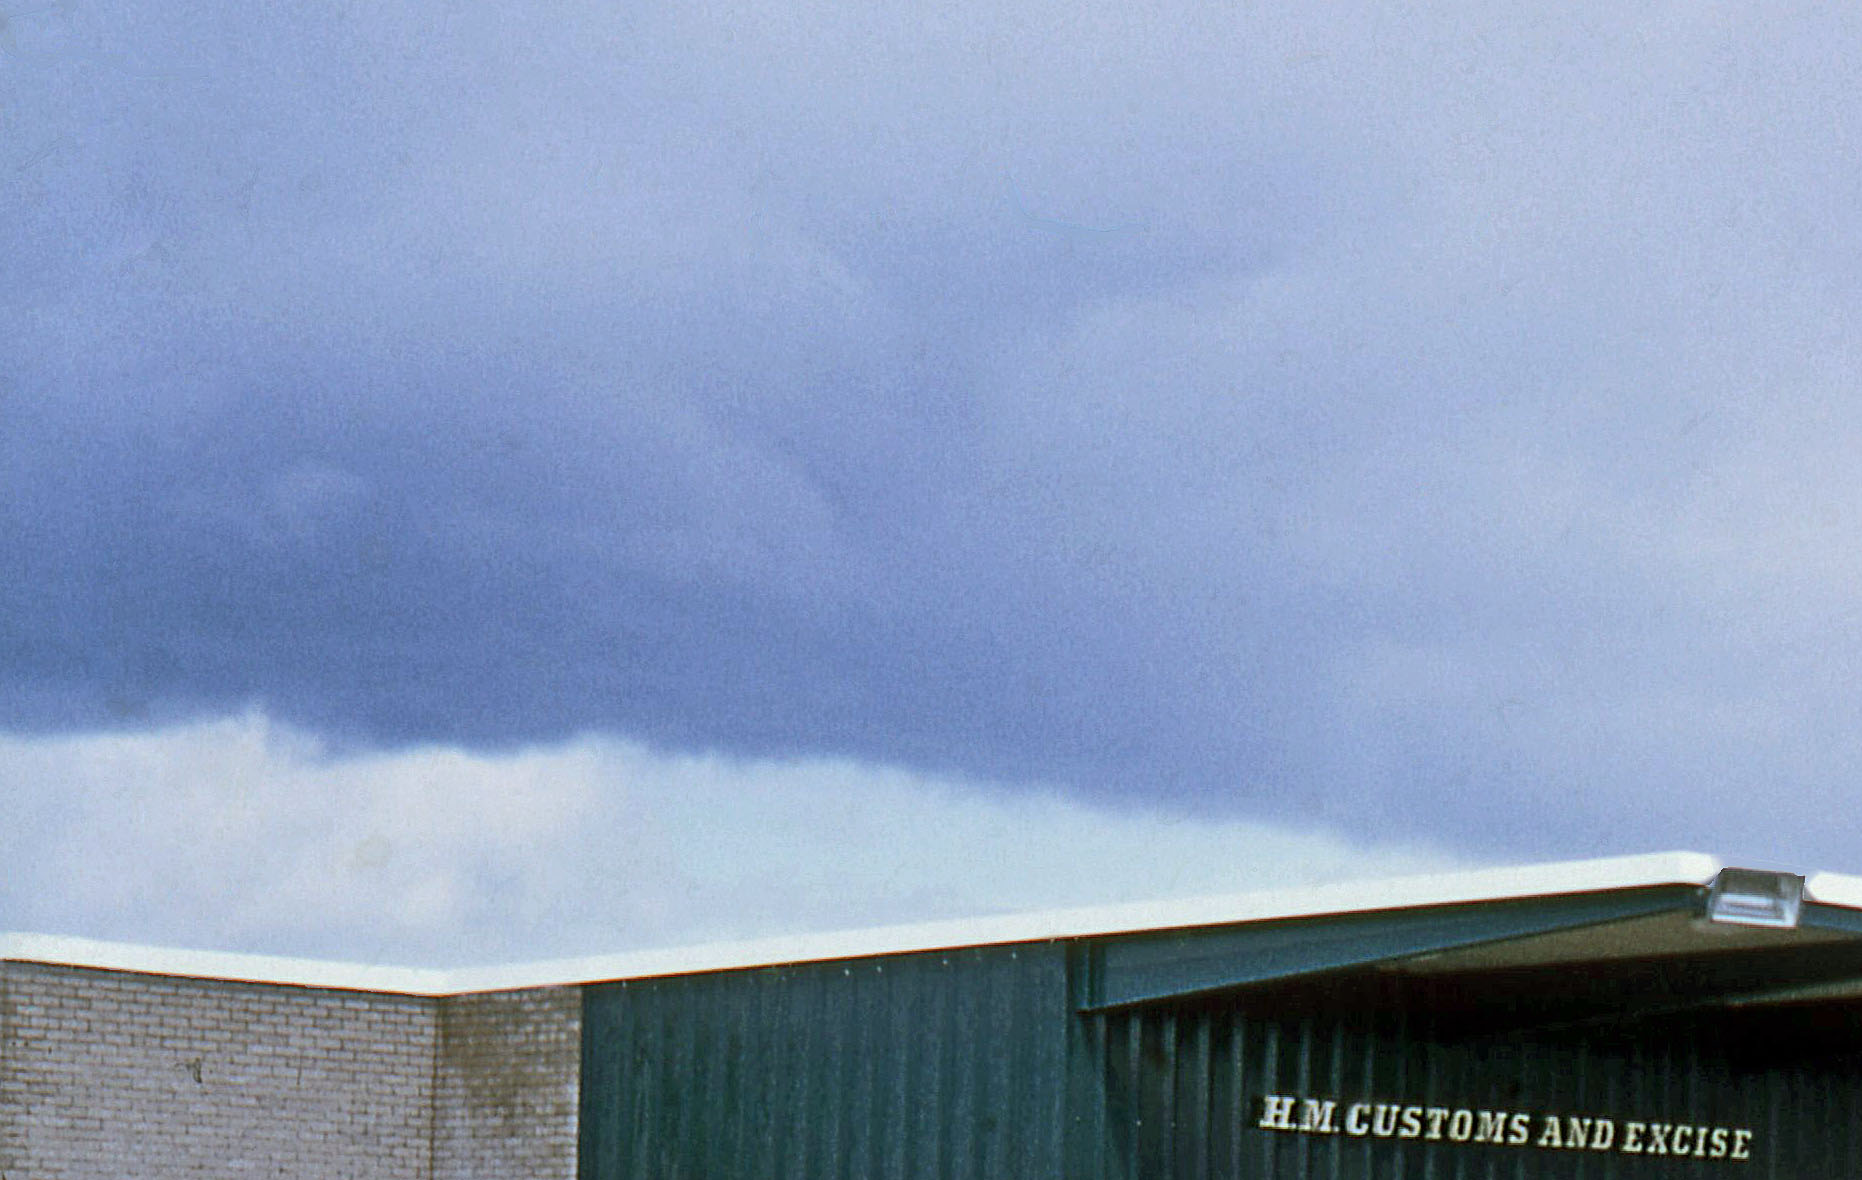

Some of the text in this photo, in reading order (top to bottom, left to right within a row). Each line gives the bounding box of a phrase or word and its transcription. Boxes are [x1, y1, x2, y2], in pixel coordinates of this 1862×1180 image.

[1345, 1102, 1530, 1146] CUSTOMS
[1536, 1114, 1615, 1152] AND
[1621, 1121, 1753, 1161] EXCISE
